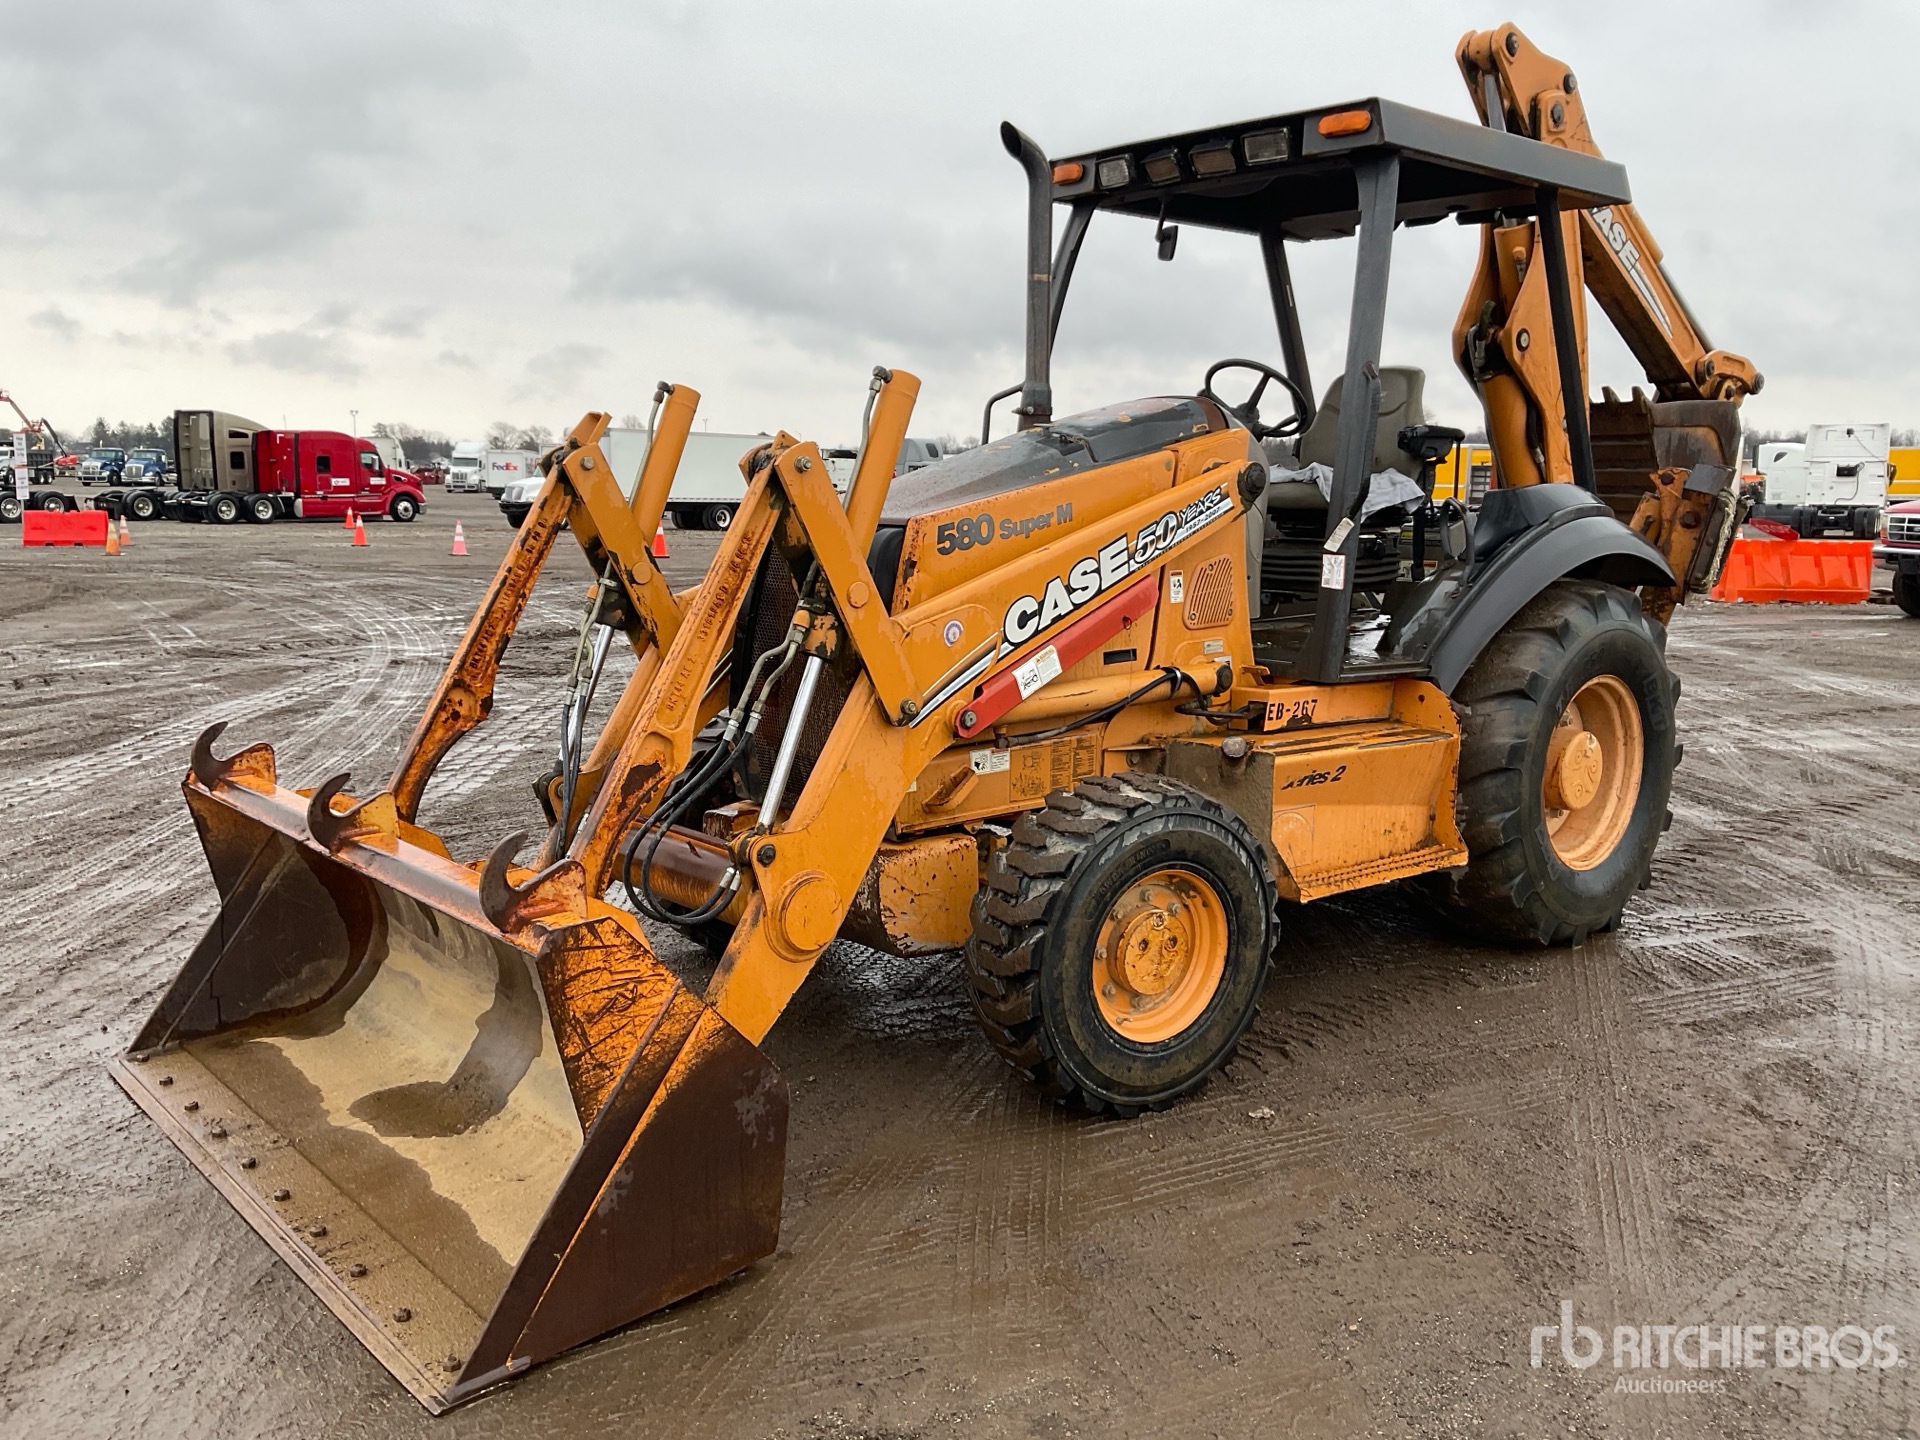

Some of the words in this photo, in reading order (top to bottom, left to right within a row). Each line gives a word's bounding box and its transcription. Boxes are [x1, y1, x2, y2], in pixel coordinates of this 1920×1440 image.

[1588, 207, 1640, 272] ASE
[491, 462, 518, 471] FedEx
[936, 513, 995, 555] 580
[1000, 511, 1054, 540] Super
[1056, 502, 1073, 525] M
[1186, 507, 1221, 533] 1957-2007
[1004, 533, 1131, 644] CASE
[1134, 511, 1179, 563] 50
[1179, 486, 1222, 529] YEARS
[1267, 699, 1318, 721] EB-267
[1330, 765, 1347, 782] 2
